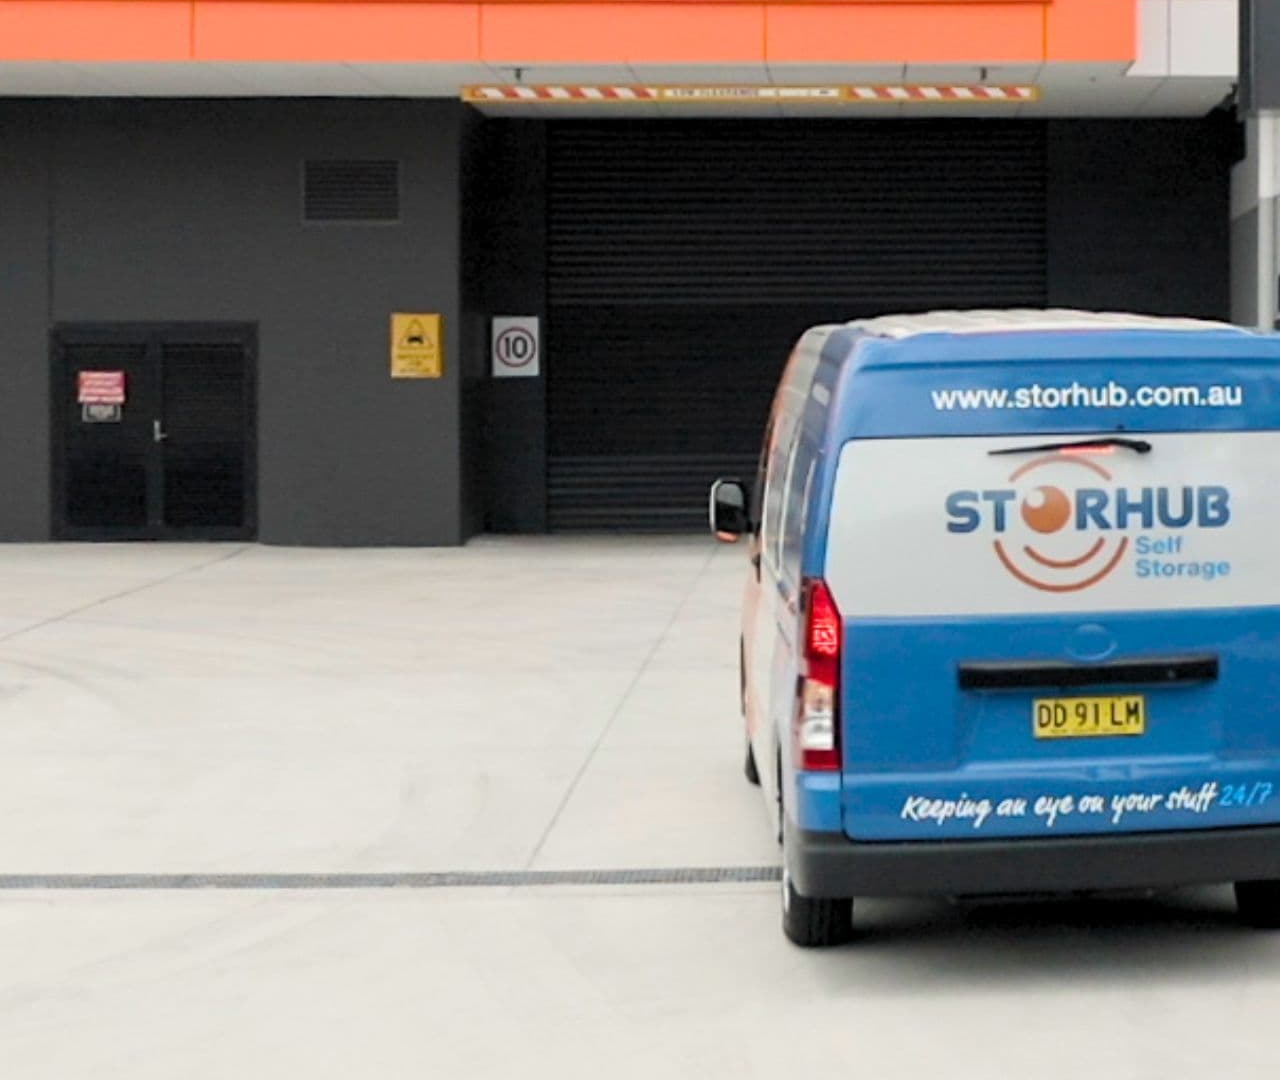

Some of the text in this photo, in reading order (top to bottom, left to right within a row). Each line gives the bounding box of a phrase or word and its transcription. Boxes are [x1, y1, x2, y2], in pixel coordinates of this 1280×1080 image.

[505, 336, 528, 359] 10
[931, 381, 1243, 410] www.storhub.com.au
[945, 485, 1231, 534] STORHUB
[1135, 536, 1183, 555] Self
[1135, 558, 1231, 580] Storage
[1037, 700, 1140, 728] DD 91 LM
[901, 782, 1273, 828] Keeping an eye on your stuff 24/7
